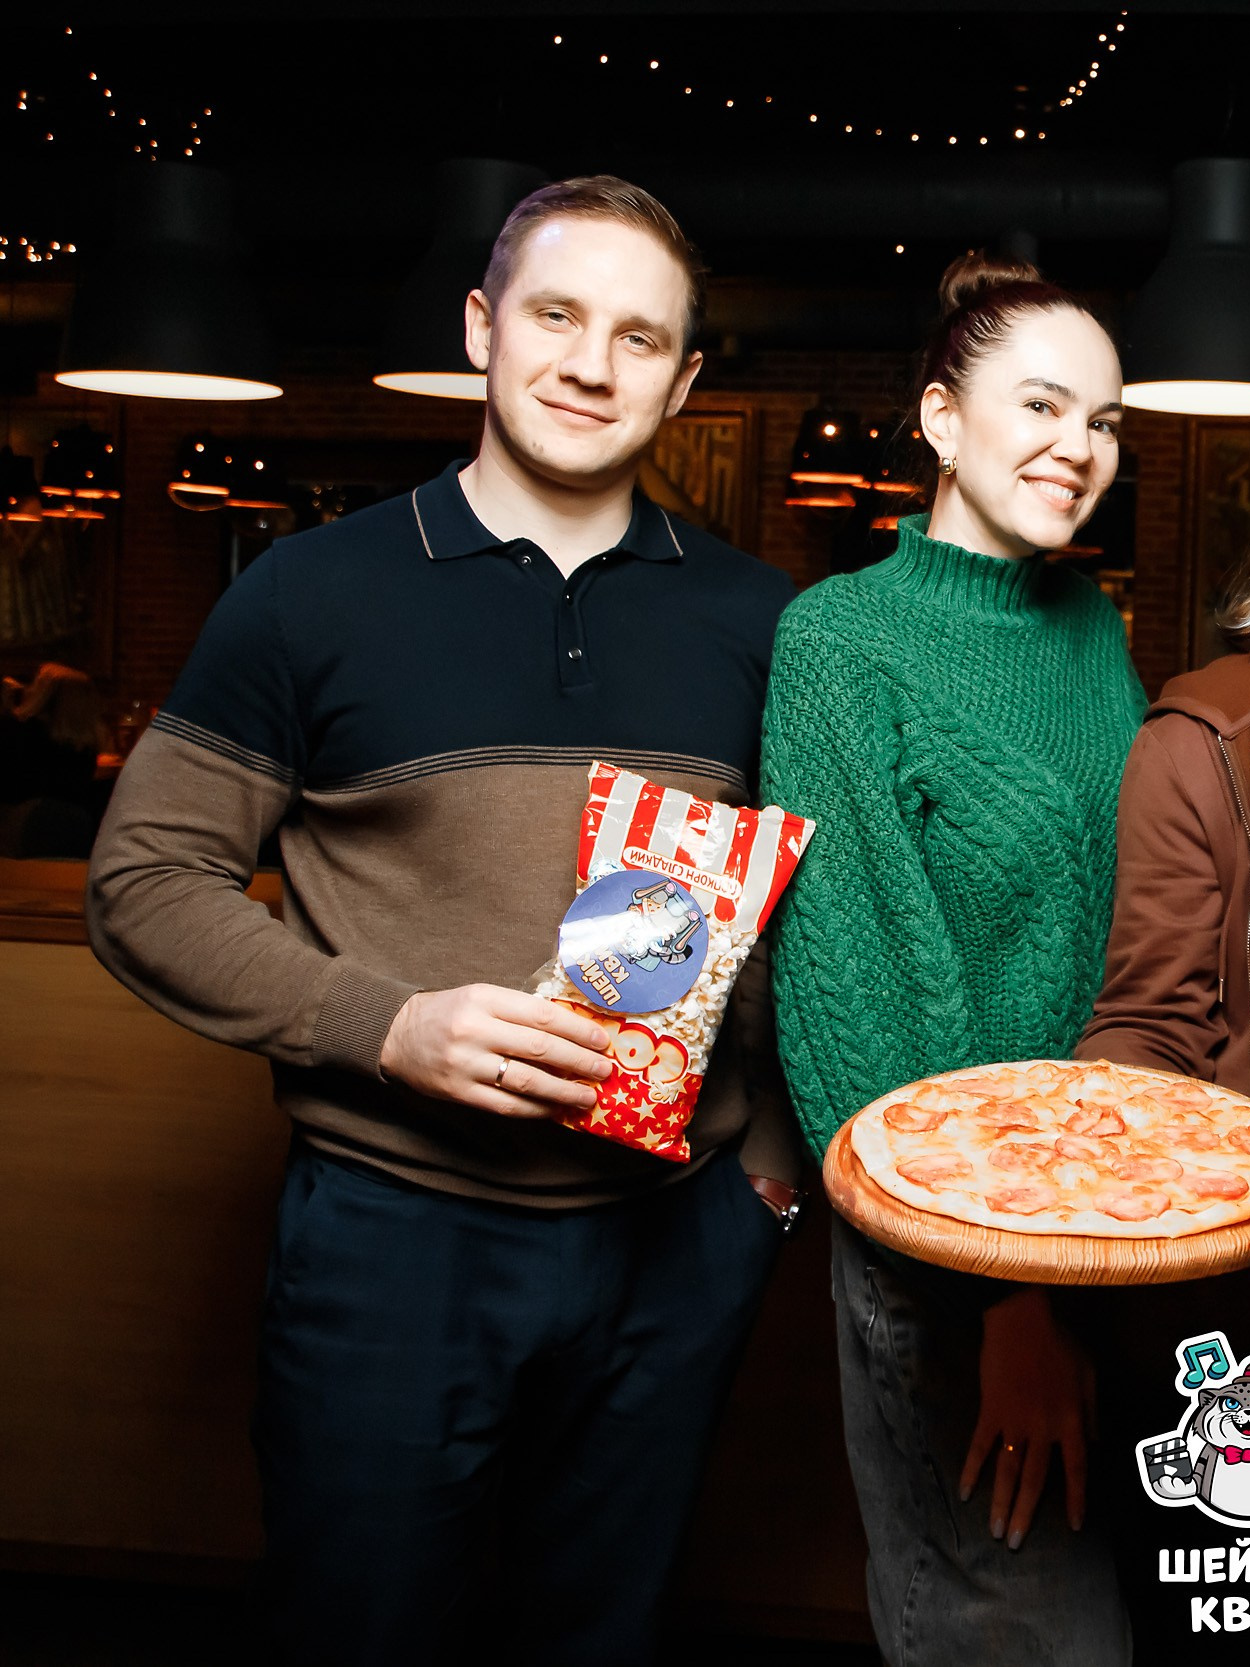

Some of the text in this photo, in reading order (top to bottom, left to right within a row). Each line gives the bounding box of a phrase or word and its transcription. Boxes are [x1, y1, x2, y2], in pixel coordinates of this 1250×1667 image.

[630, 849, 684, 879] СЛАДКИЙ
[574, 950, 622, 1007] ШЕЙК
[594, 944, 630, 984] КВИ
